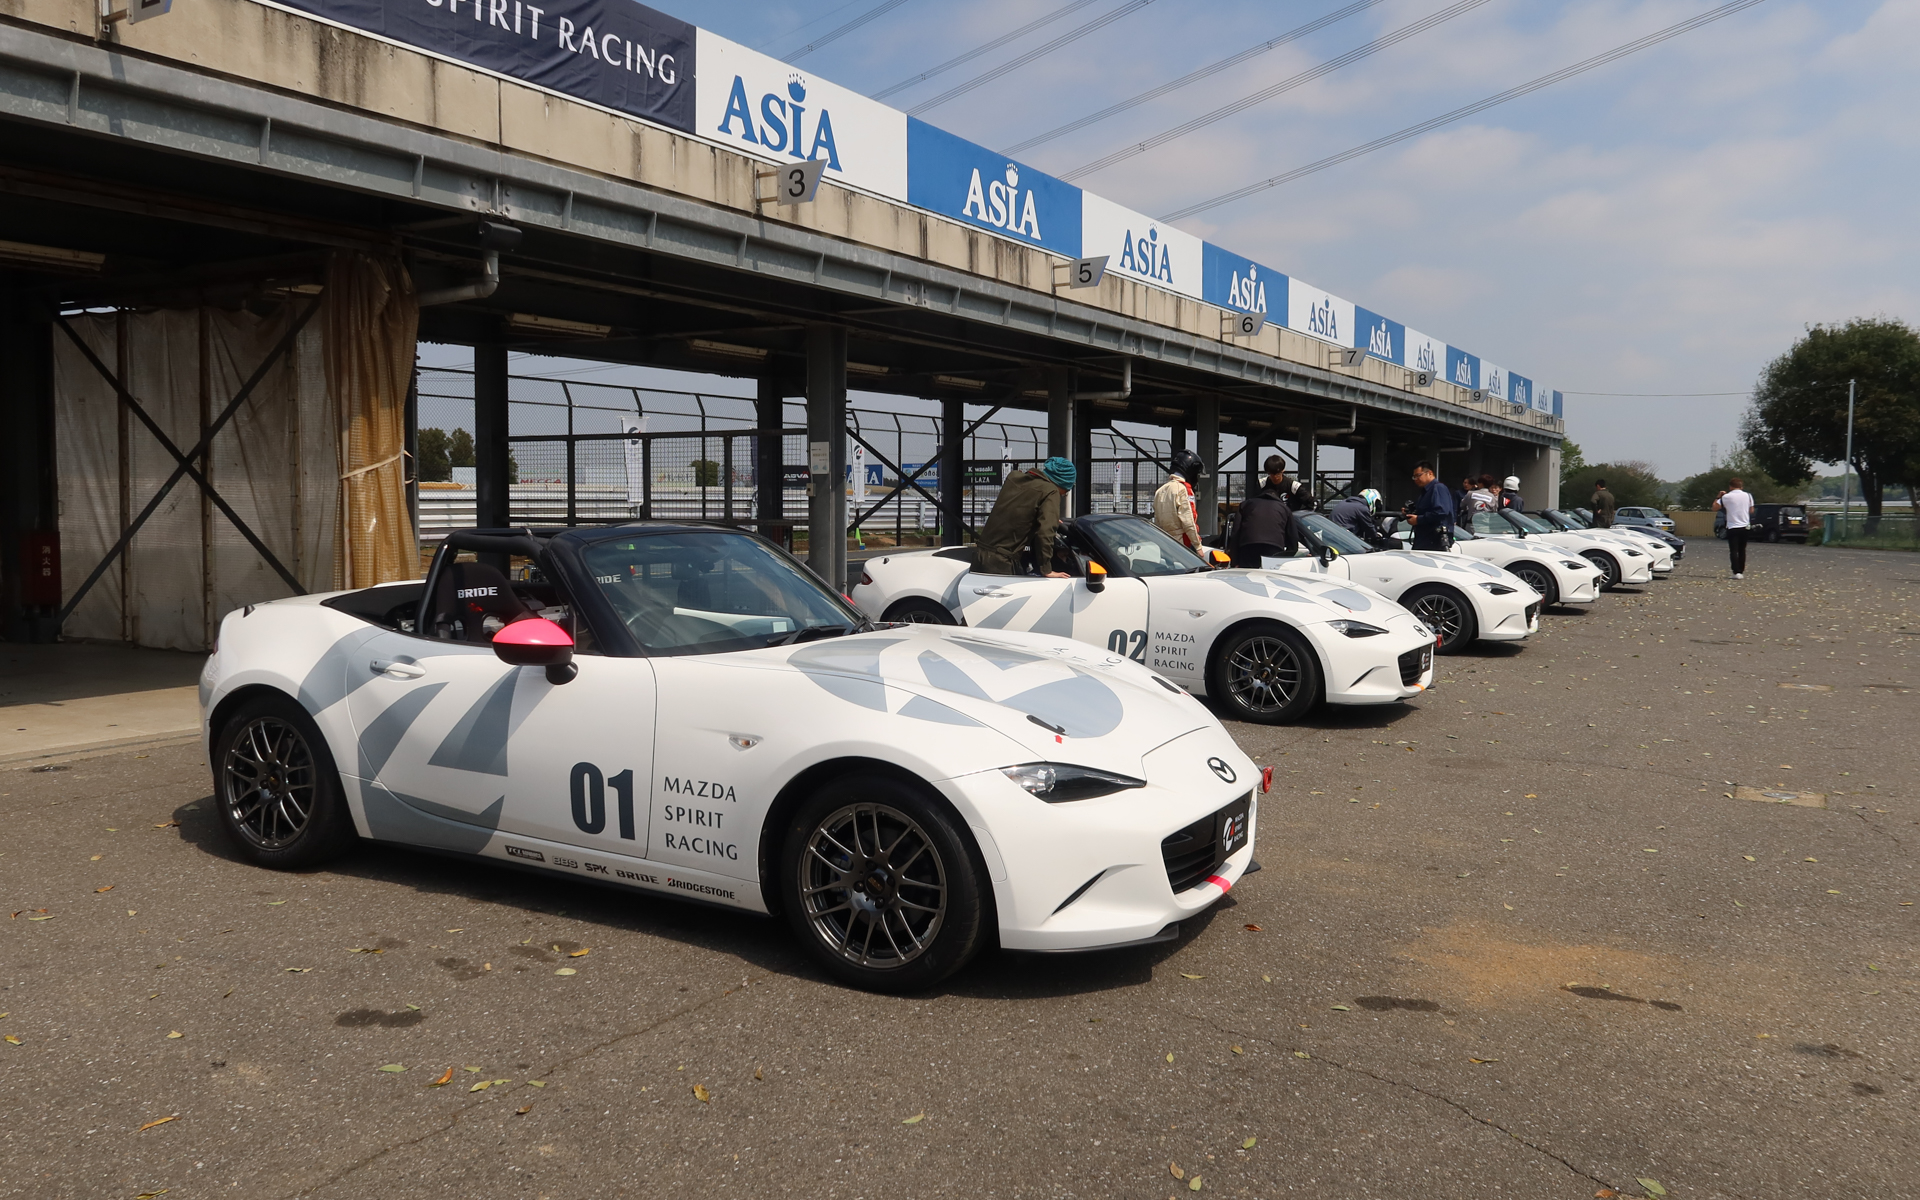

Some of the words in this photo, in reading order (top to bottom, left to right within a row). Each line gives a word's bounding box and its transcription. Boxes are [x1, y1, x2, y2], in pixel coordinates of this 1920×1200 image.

[426, 0, 545, 41] IRIT
[558, 16, 676, 85] RACING
[717, 74, 843, 172] ASIA
[788, 168, 806, 197] 3
[962, 165, 1042, 240] ASIA
[1119, 227, 1173, 284] ASIA
[1078, 262, 1092, 283] 5
[1228, 266, 1268, 313] ASIA
[1241, 317, 1254, 333] 6
[1308, 297, 1338, 339] ASIA
[1368, 322, 1393, 359] ASIA
[1346, 350, 1357, 364] 7
[1416, 342, 1436, 372] ASIA
[1418, 373, 1427, 385] 8
[1455, 356, 1472, 386] ASIA
[1473, 390, 1481, 402] 9
[1512, 405, 1524, 414] 10
[1545, 416, 1554, 425] 11
[967, 465, 994, 474] Kwasaki
[970, 476, 991, 484] LAZA
[456, 586, 499, 599] BRIDE
[1108, 629, 1148, 665] 02
[1154, 631, 1196, 644] MAZDA
[1154, 645, 1188, 657] SPIRIT
[1154, 658, 1195, 671] RACING
[570, 761, 636, 841] 01
[663, 776, 737, 803] MAZDA
[664, 805, 724, 829] SPIRIT
[665, 832, 738, 860] RACING
[552, 856, 578, 869] BBS
[584, 862, 610, 875] SPK
[615, 869, 660, 885] BRIDE
[667, 877, 736, 901] BRIDGESTONE
